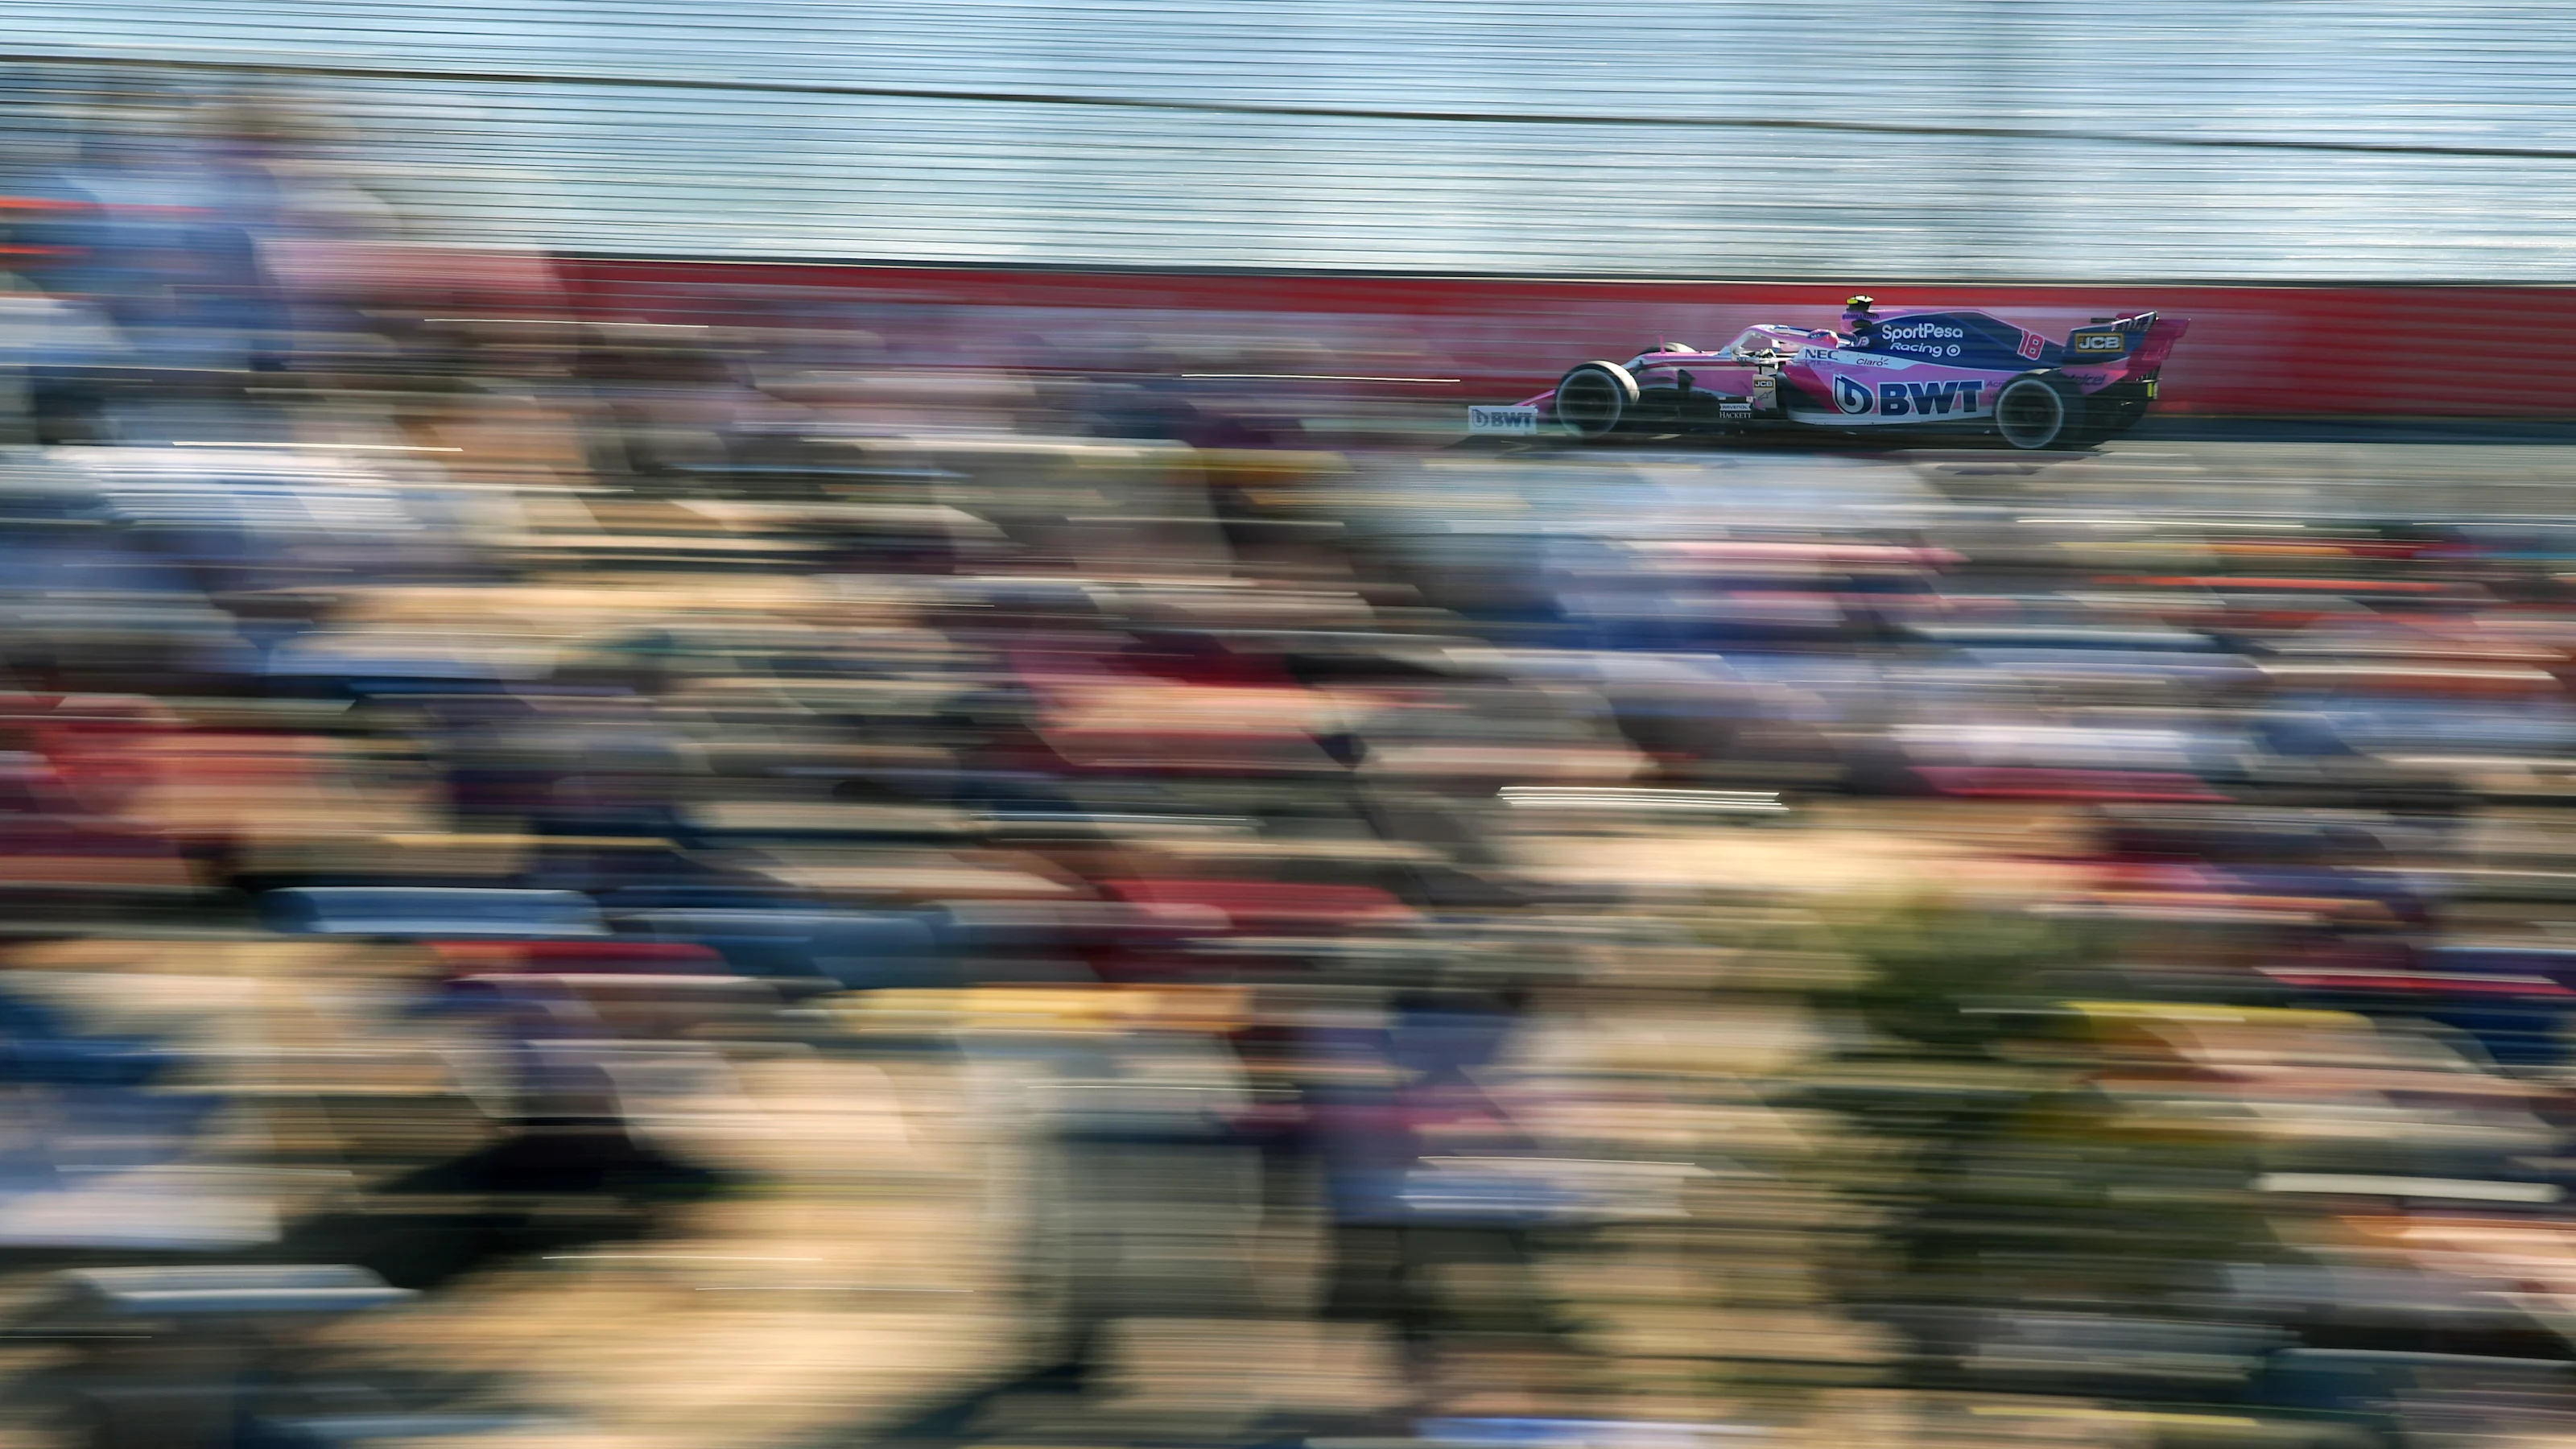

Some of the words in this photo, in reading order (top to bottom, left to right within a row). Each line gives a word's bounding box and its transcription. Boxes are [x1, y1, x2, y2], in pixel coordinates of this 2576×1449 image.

[1881, 323, 1963, 342] SportPesa
[1889, 342, 1943, 357] Racing
[2017, 328, 2046, 361] 18
[2079, 336, 2120, 349] JCB
[1805, 349, 1839, 361] NEC
[1856, 357, 1884, 366] Claro
[1879, 381, 1984, 415] BWT
[1491, 411, 1532, 427] BWT
